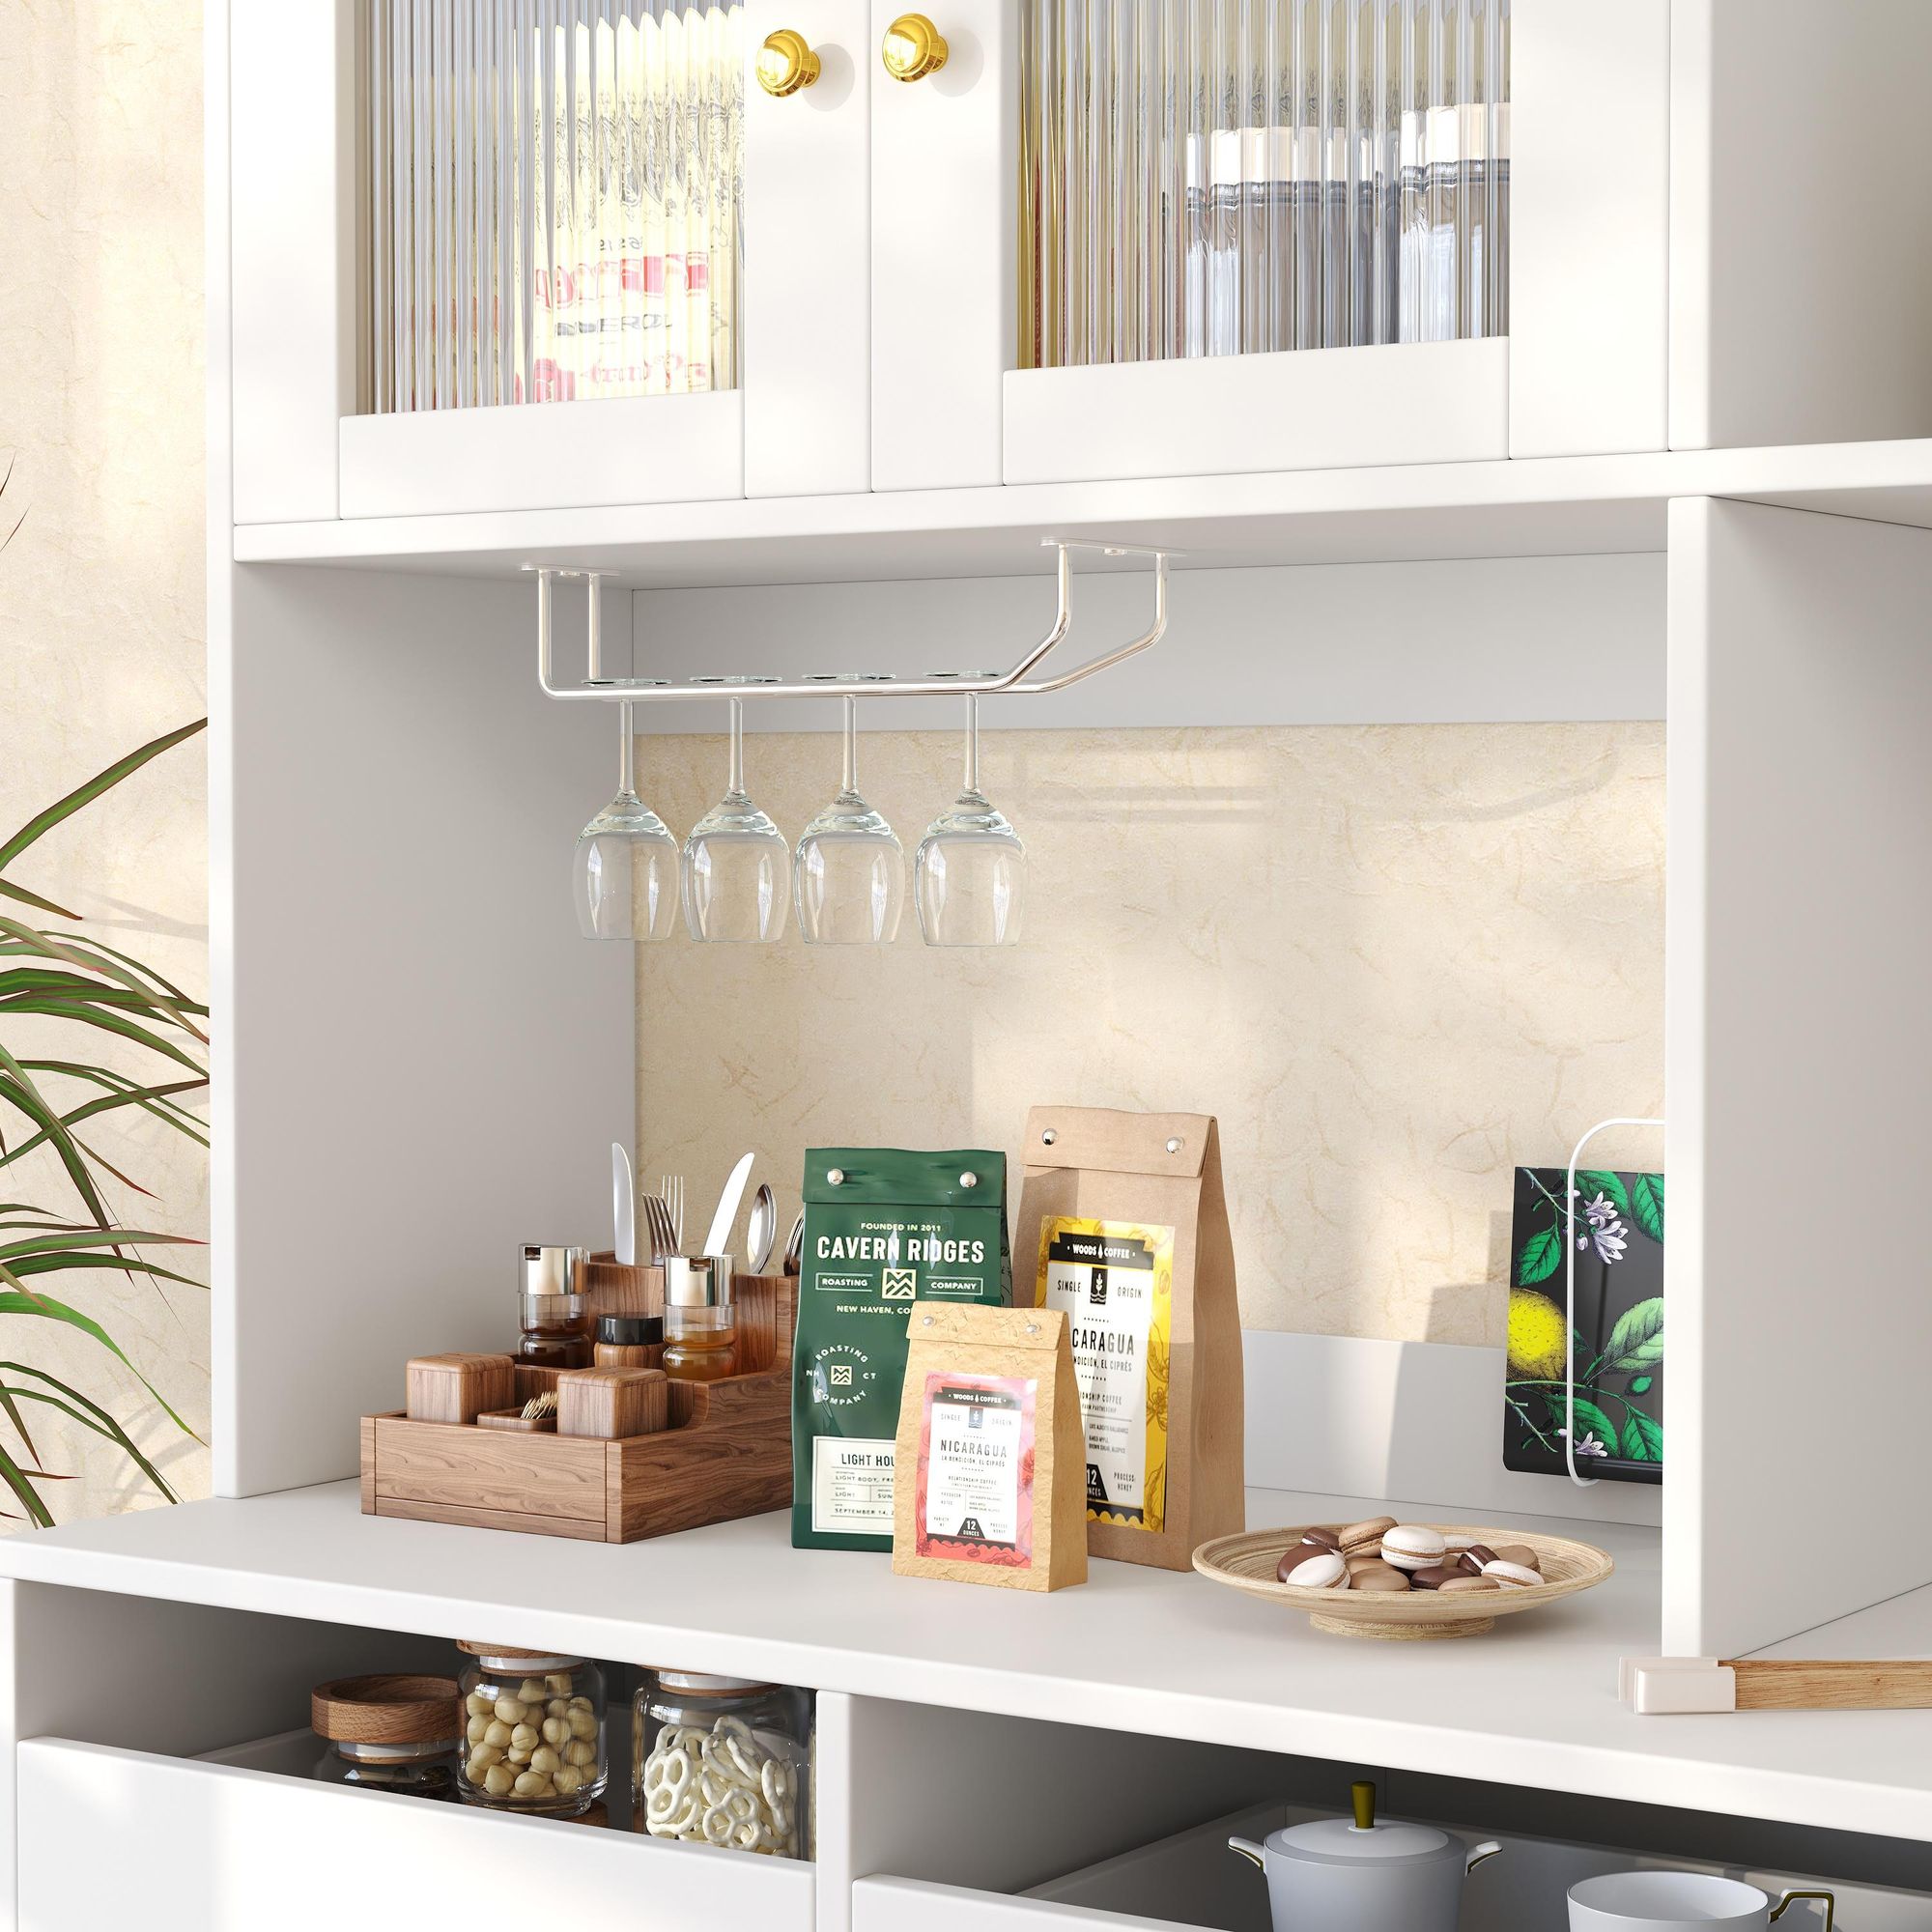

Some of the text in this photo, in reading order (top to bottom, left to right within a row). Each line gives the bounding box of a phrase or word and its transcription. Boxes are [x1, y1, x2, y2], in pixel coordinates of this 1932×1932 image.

[861, 1222, 904, 1232] FOUNDED
[816, 1236, 985, 1264] CAVERN RIDGES
[1072, 1243, 1129, 1259] WOODS COFFEE
[821, 1277, 977, 1291] ROASTING COMPANY
[1057, 1279, 1080, 1292] SINGLE
[1117, 1286, 1142, 1298] ORIGIN
[836, 1304, 912, 1316] NEW HAVEN, CO
[1071, 1327, 1134, 1355] CARAGUA
[814, 1344, 869, 1363] ROASTING
[1100, 1358, 1107, 1369] EL
[862, 1372, 877, 1380] CT
[817, 1388, 867, 1406] COMPANY
[952, 1393, 975, 1402] WOODS
[940, 1439, 1007, 1458] NICARAGUA
[841, 1454, 895, 1466] LIGHT HOU
[1087, 1468, 1096, 1485] 12
[1114, 1471, 1134, 1482] PROCESS
[1088, 1488, 1101, 1497] NCES
[1117, 1483, 1133, 1492] HONEY
[966, 1520, 977, 1530] 12
